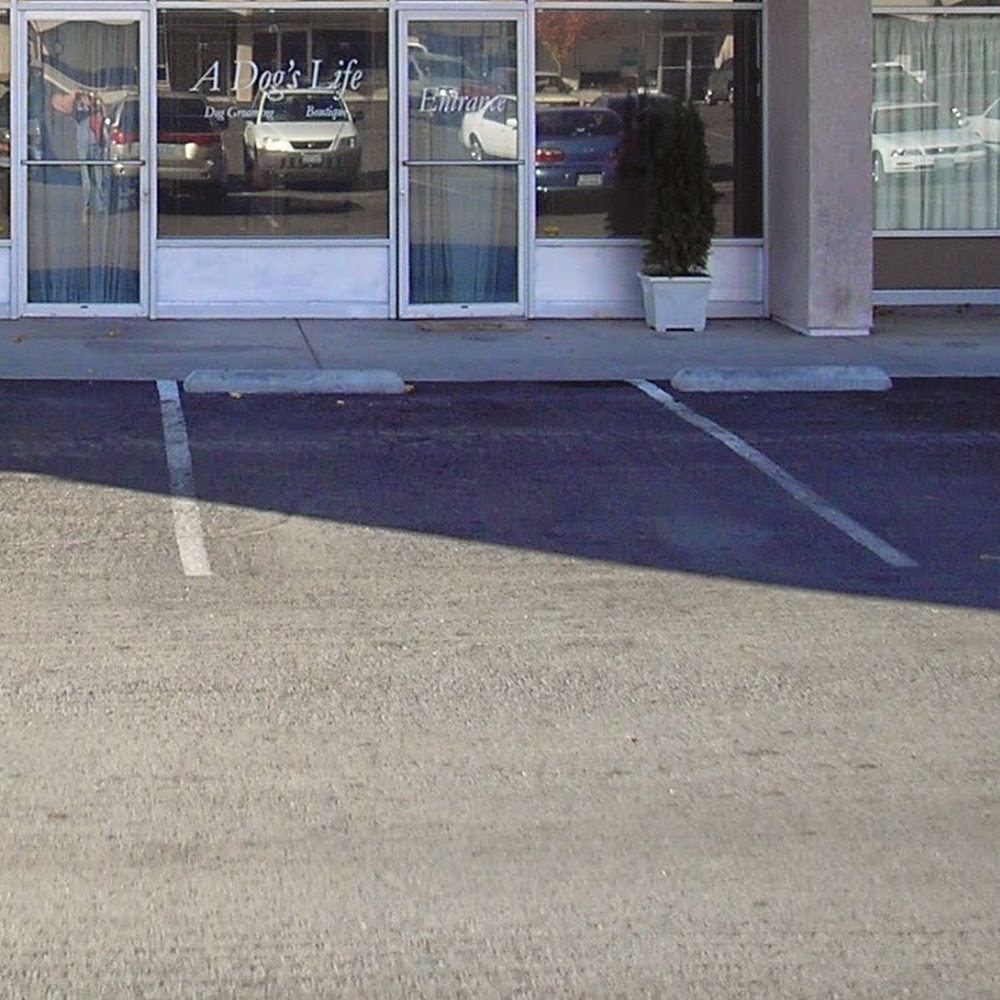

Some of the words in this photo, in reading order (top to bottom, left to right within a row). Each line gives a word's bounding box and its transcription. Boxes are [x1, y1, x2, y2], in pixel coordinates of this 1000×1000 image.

[189, 60, 221, 92] A
[231, 59, 300, 101] Dog's
[309, 59, 363, 99] Life
